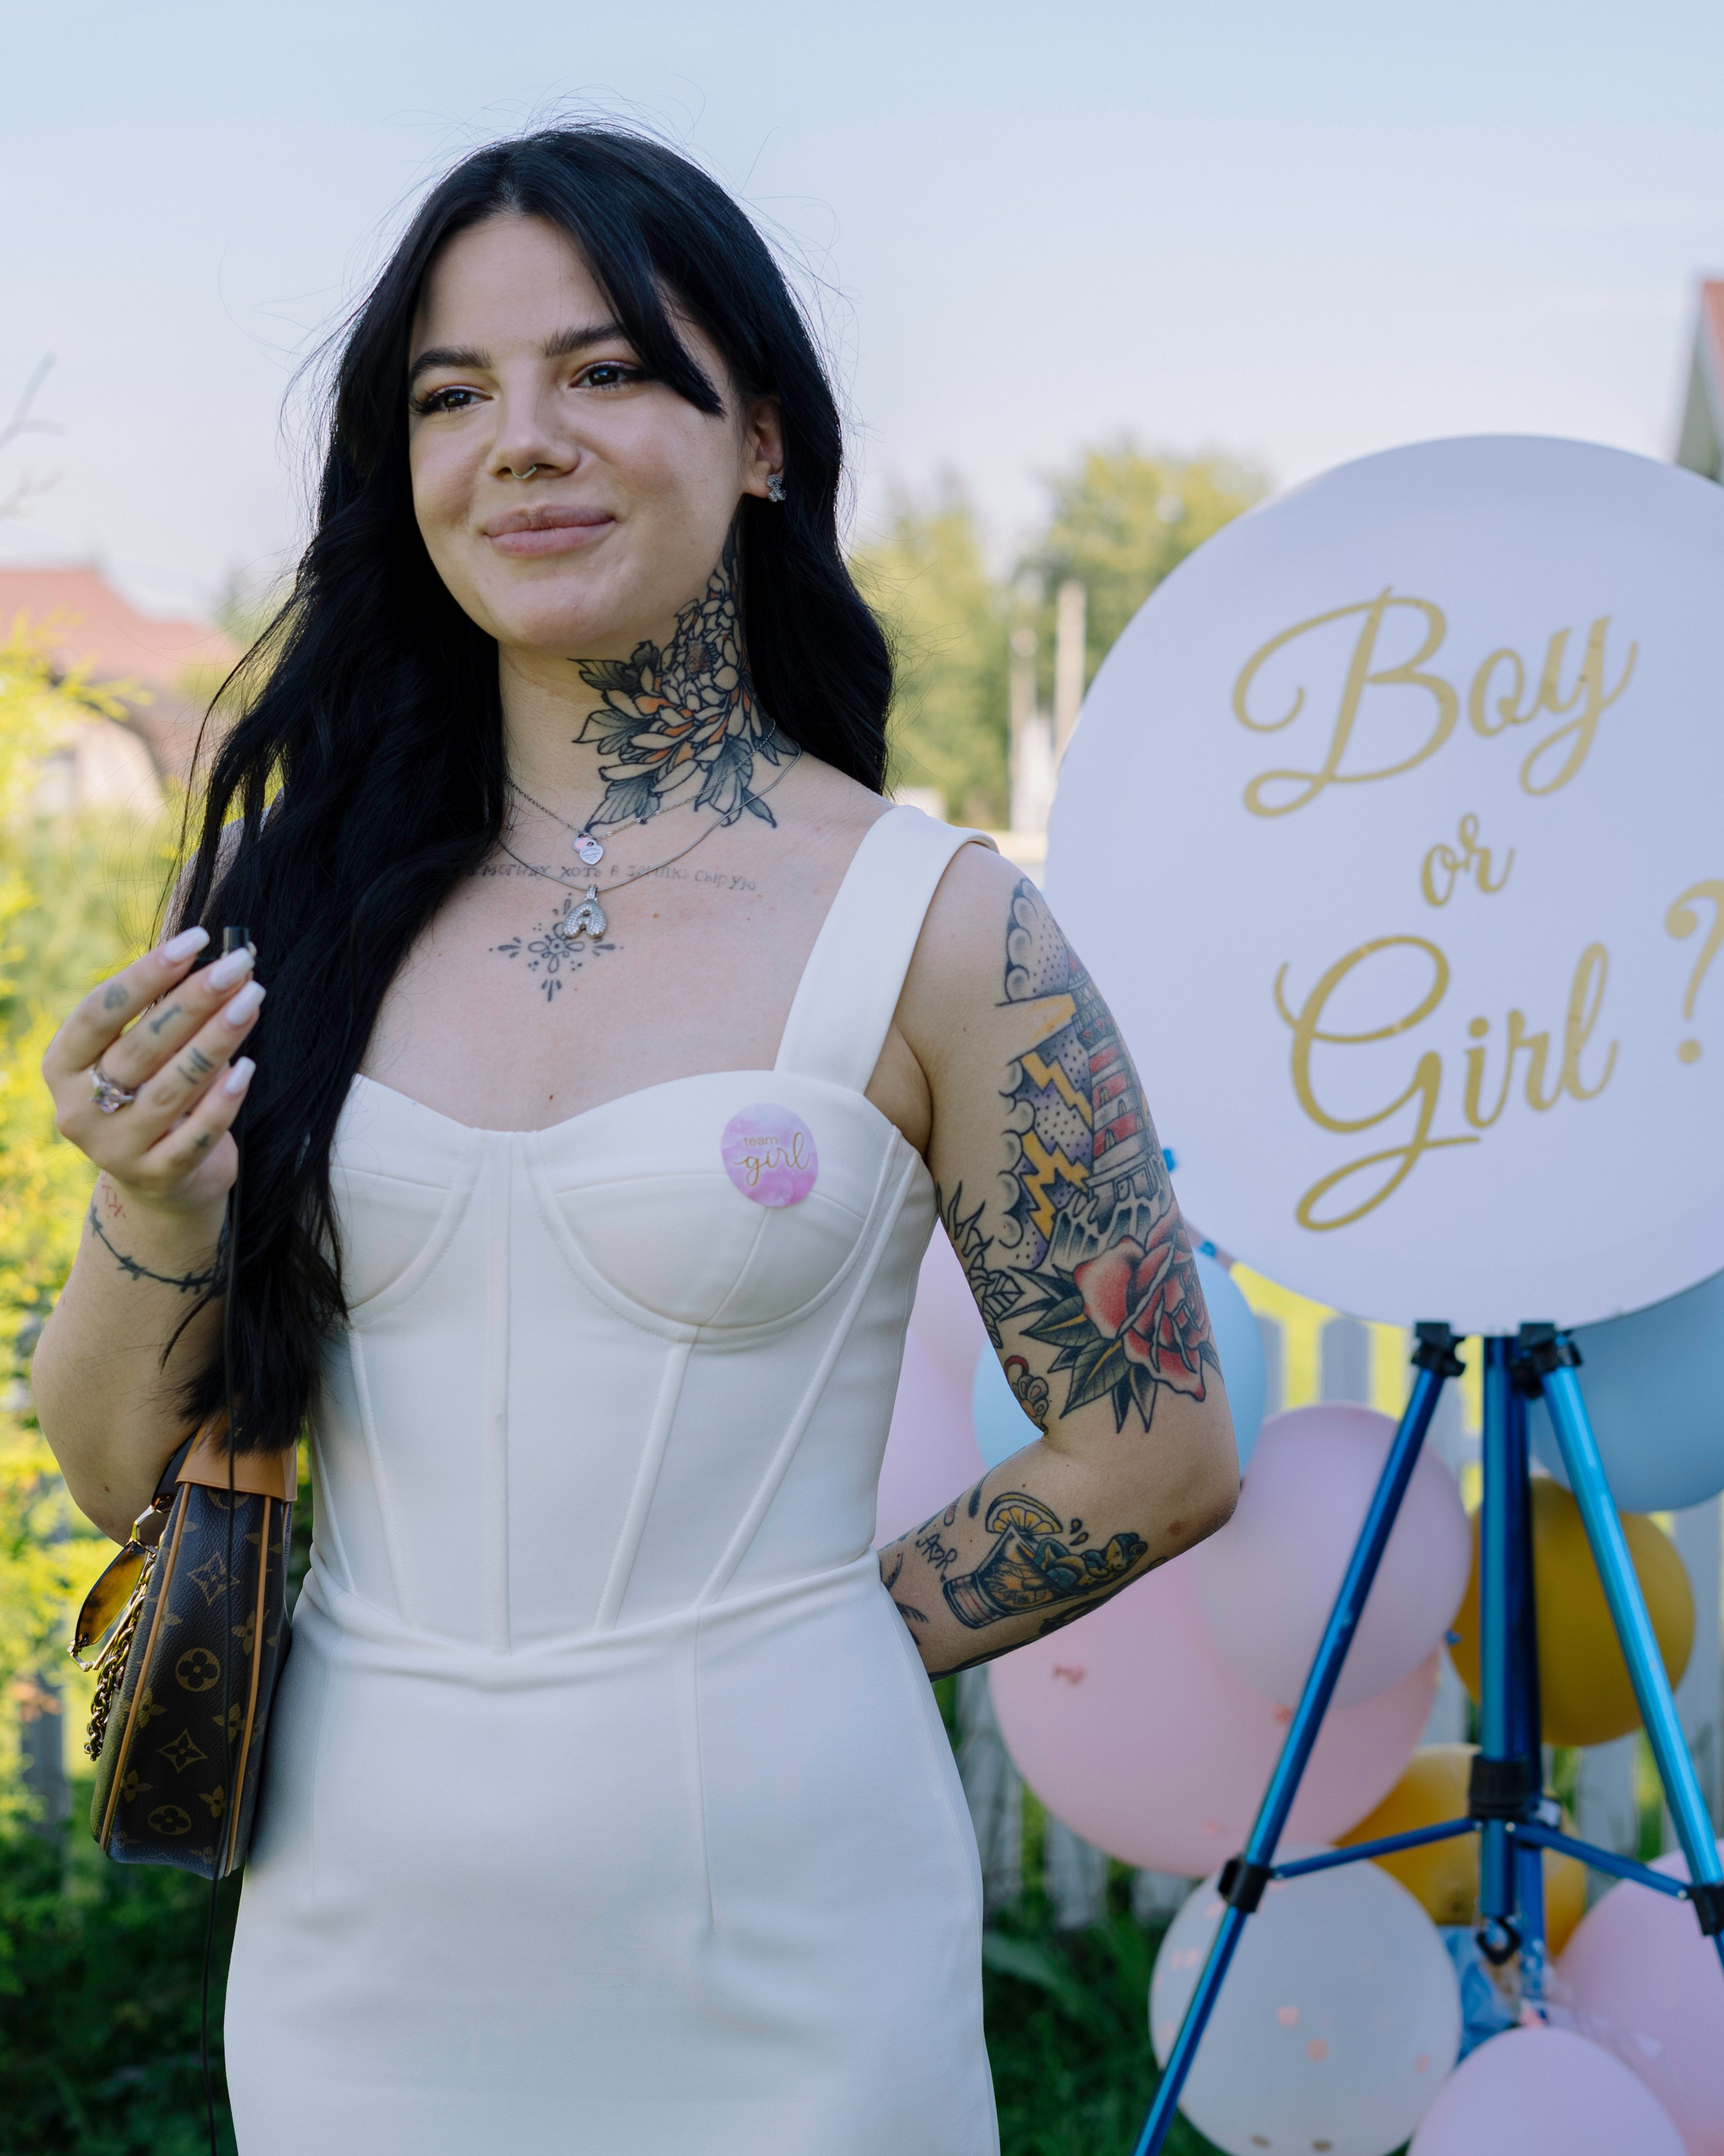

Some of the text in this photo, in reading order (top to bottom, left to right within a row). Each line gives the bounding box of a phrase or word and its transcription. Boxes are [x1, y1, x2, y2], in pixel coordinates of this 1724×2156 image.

[1232, 585, 1638, 818] Boy
[1421, 813, 1515, 907] or
[1273, 935, 1618, 1232] Girl
[733, 1132, 811, 1187] girl
[743, 1136, 778, 1146] team
